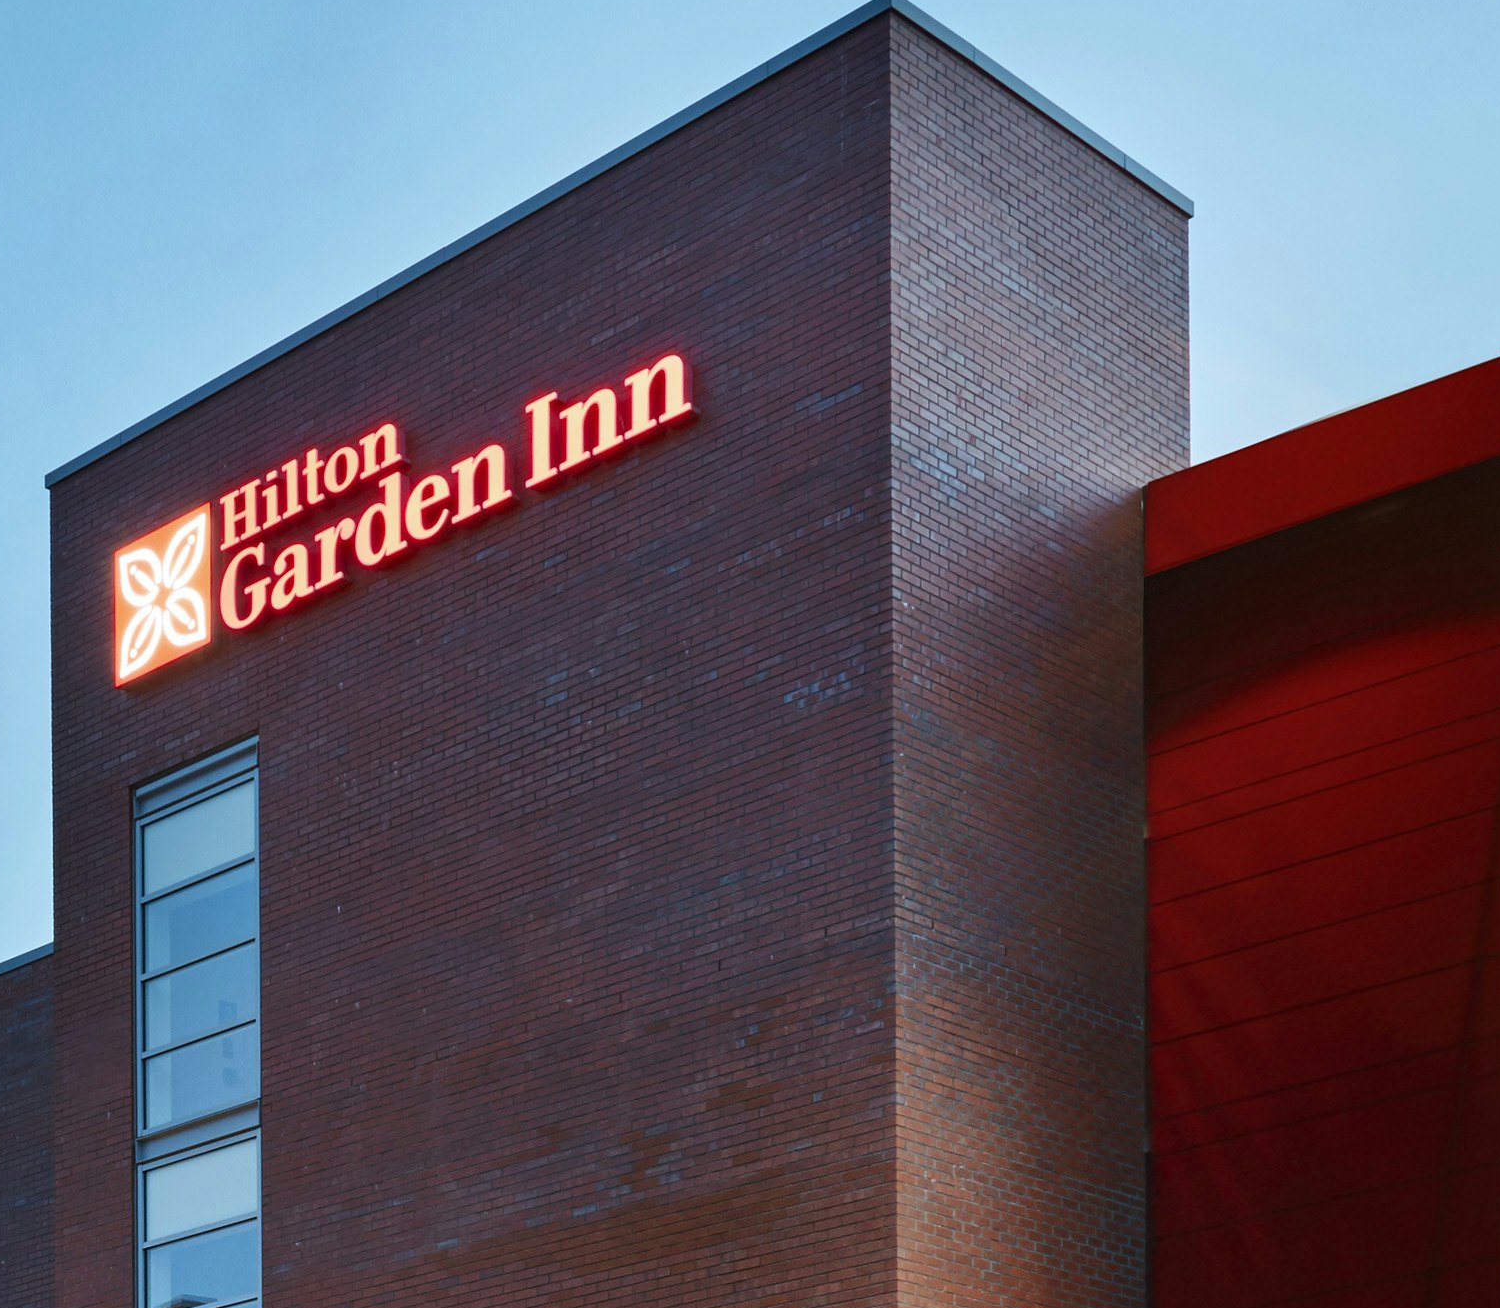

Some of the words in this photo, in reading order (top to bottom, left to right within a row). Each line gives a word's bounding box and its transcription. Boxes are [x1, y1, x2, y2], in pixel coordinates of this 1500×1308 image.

[218, 443, 513, 630] Garden
[524, 353, 693, 489] Inn
[219, 422, 403, 550] Hilton
